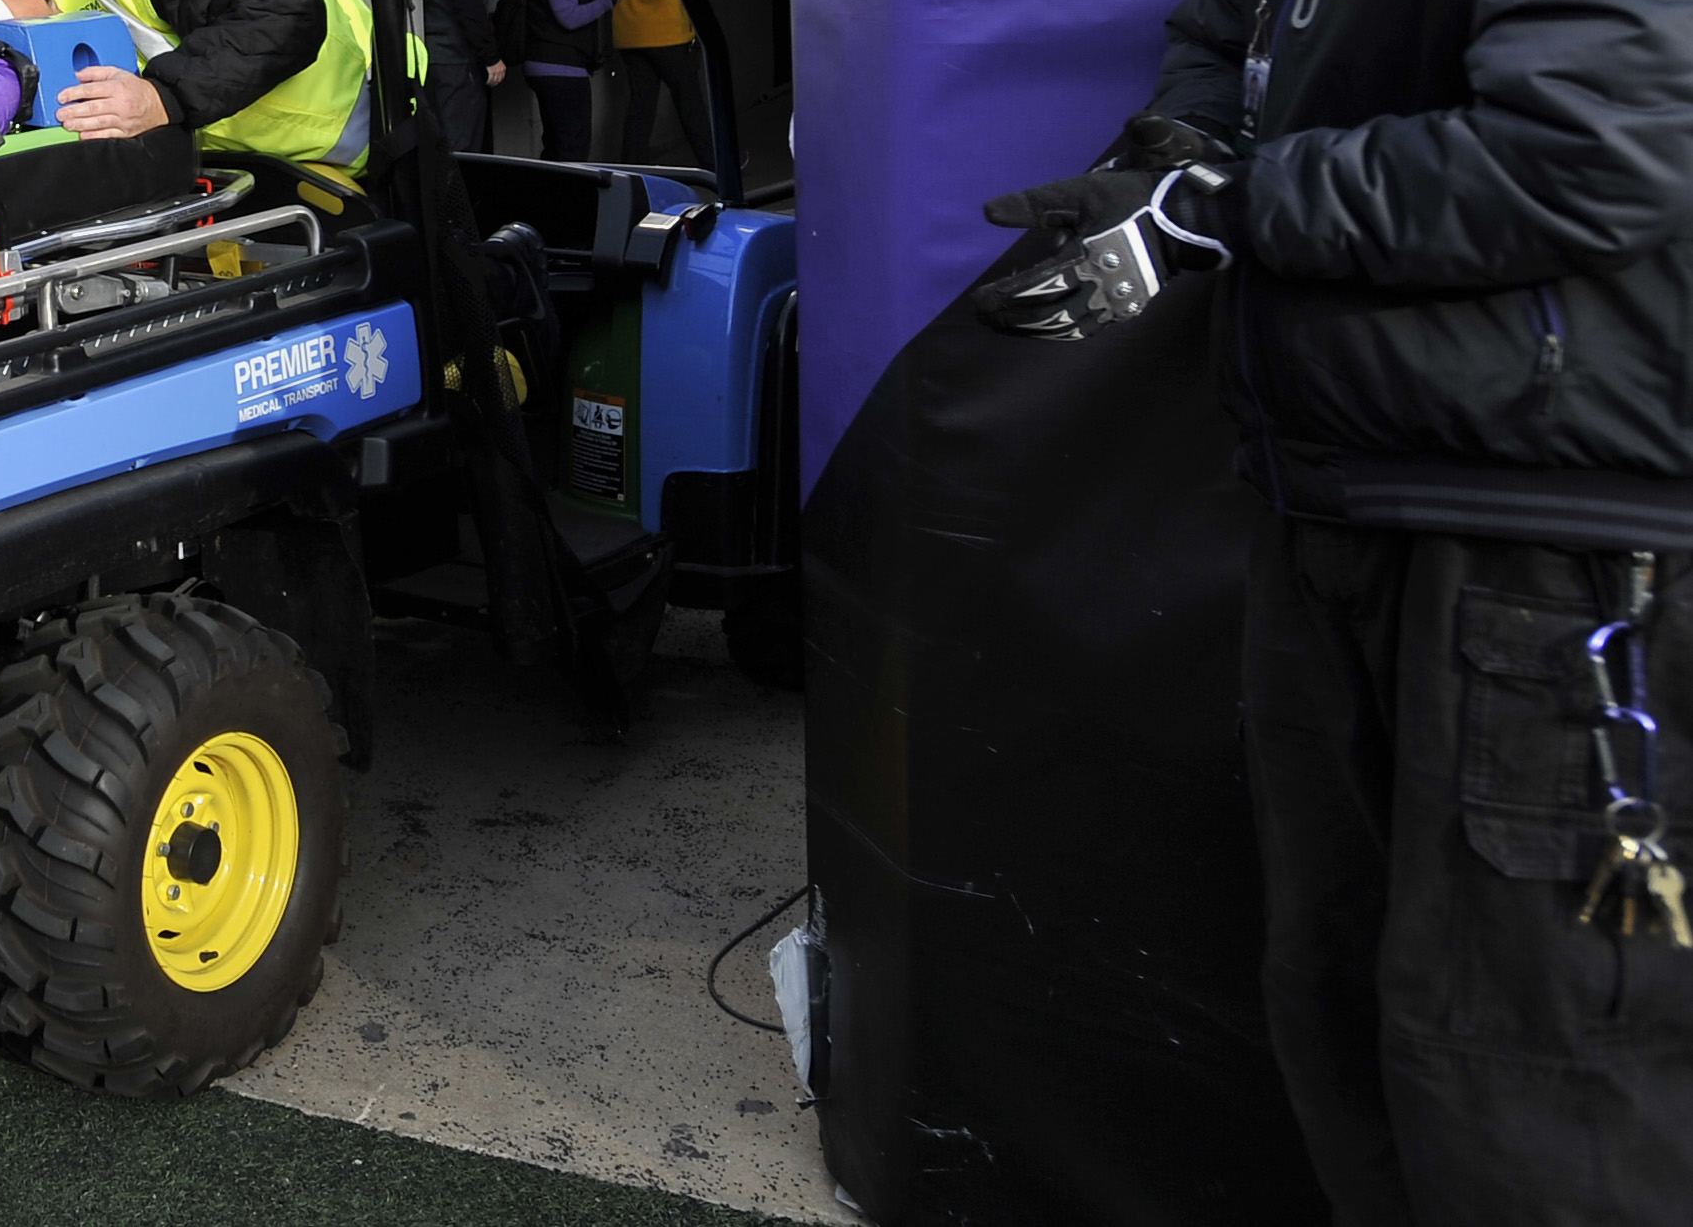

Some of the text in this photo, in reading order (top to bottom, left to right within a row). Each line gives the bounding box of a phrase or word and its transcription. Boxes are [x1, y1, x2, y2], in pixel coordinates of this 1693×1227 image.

[234, 334, 337, 396] PREMIER
[238, 377, 340, 423] MEDICAL TRANSPORT
